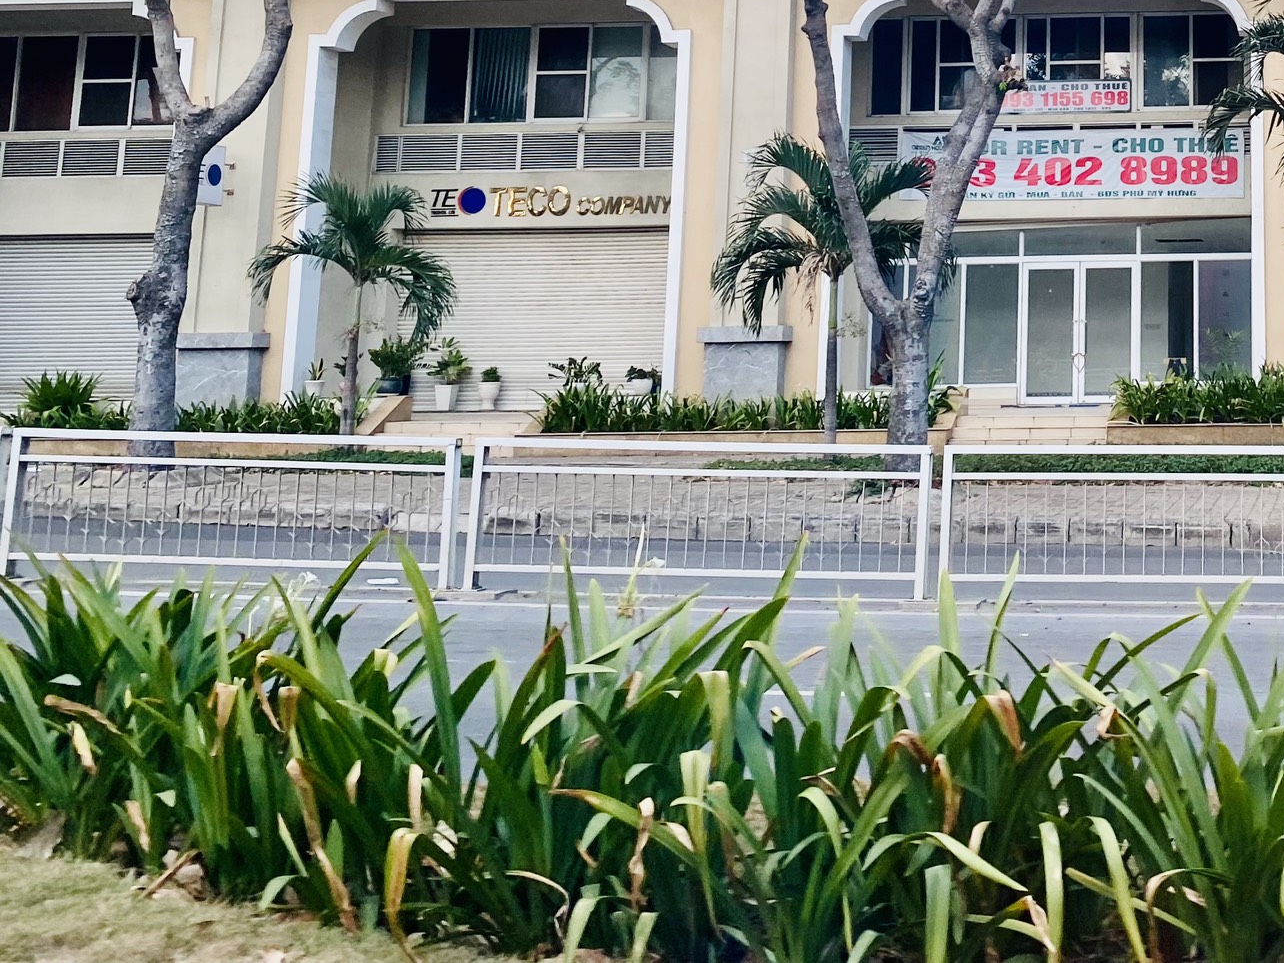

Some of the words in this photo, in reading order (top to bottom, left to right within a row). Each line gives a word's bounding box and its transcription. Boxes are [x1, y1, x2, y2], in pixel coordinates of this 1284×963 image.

[1061, 83, 1089, 91] CHO
[1040, 92, 1084, 107] 1155
[1091, 91, 1128, 106] 698
[1017, 139, 1084, 155] RENT
[1112, 137, 1165, 153] CHO
[1013, 156, 1103, 187] 402
[1119, 155, 1239, 185] 8989
[490, 185, 571, 217] TECO
[576, 195, 672, 217] COMPANY
[1027, 191, 1051, 199] MUA
